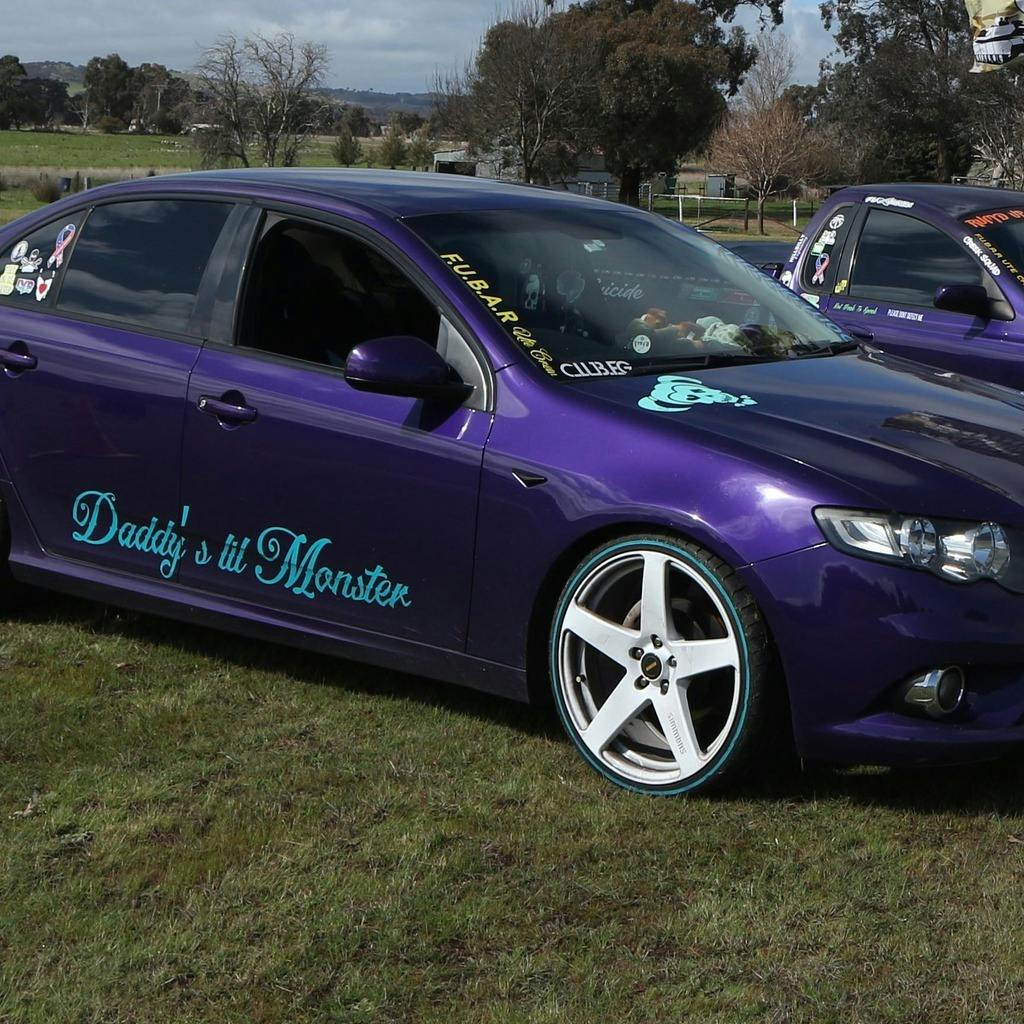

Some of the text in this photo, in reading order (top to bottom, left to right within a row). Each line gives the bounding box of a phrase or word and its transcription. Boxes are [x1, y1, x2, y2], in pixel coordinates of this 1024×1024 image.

[440, 253, 519, 323] F.U.B.A.R
[1002, 259, 1018, 273] UTE
[218, 533, 251, 574] lil
[255, 526, 412, 608] Monster
